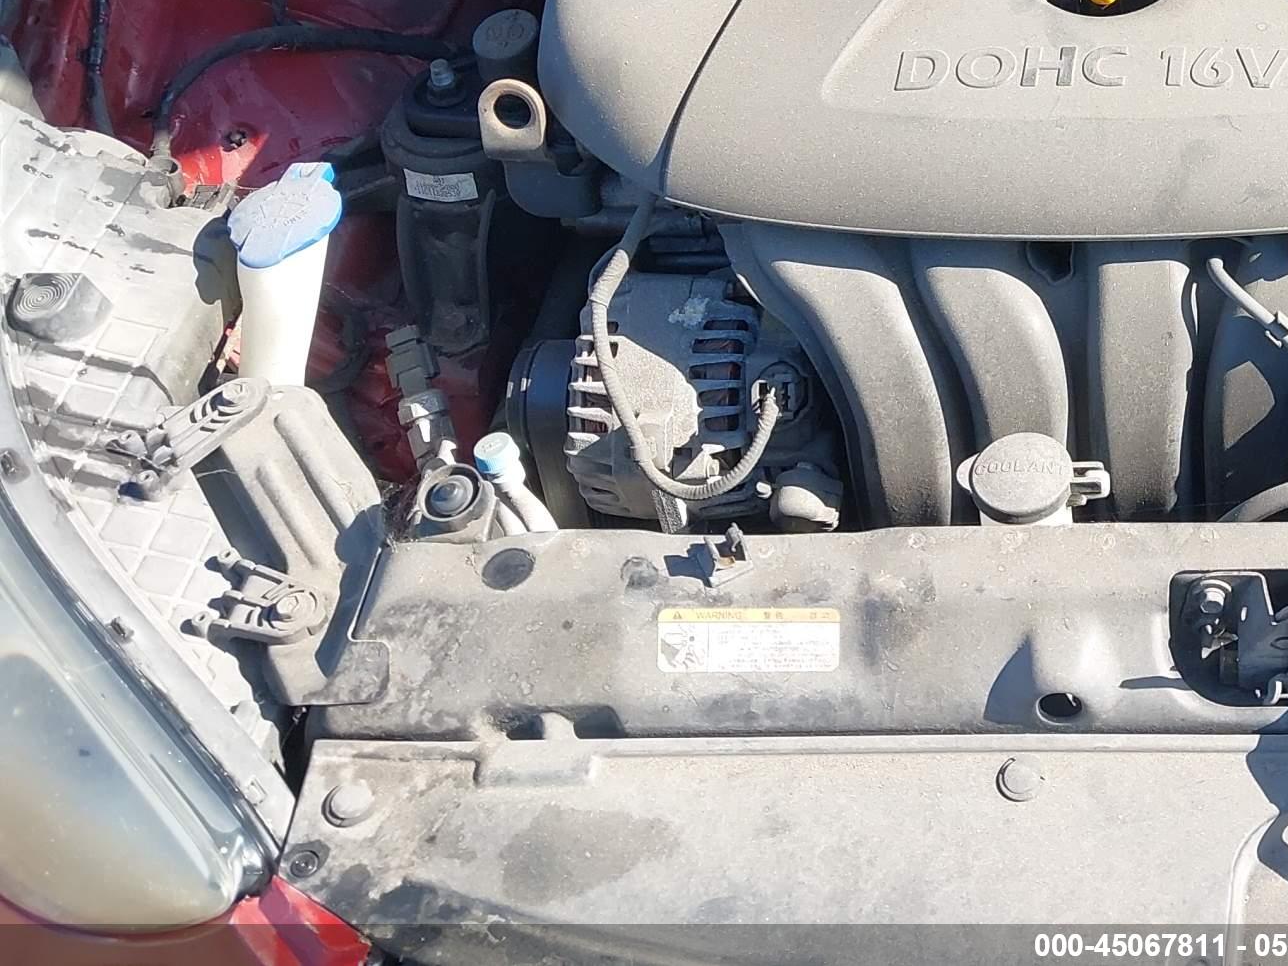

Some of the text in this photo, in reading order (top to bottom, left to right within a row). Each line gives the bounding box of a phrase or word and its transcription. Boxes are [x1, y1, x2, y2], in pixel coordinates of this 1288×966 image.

[894, 47, 1128, 91] DOHC
[974, 459, 1067, 476] COOLANT
[696, 612, 742, 620] WARNING
